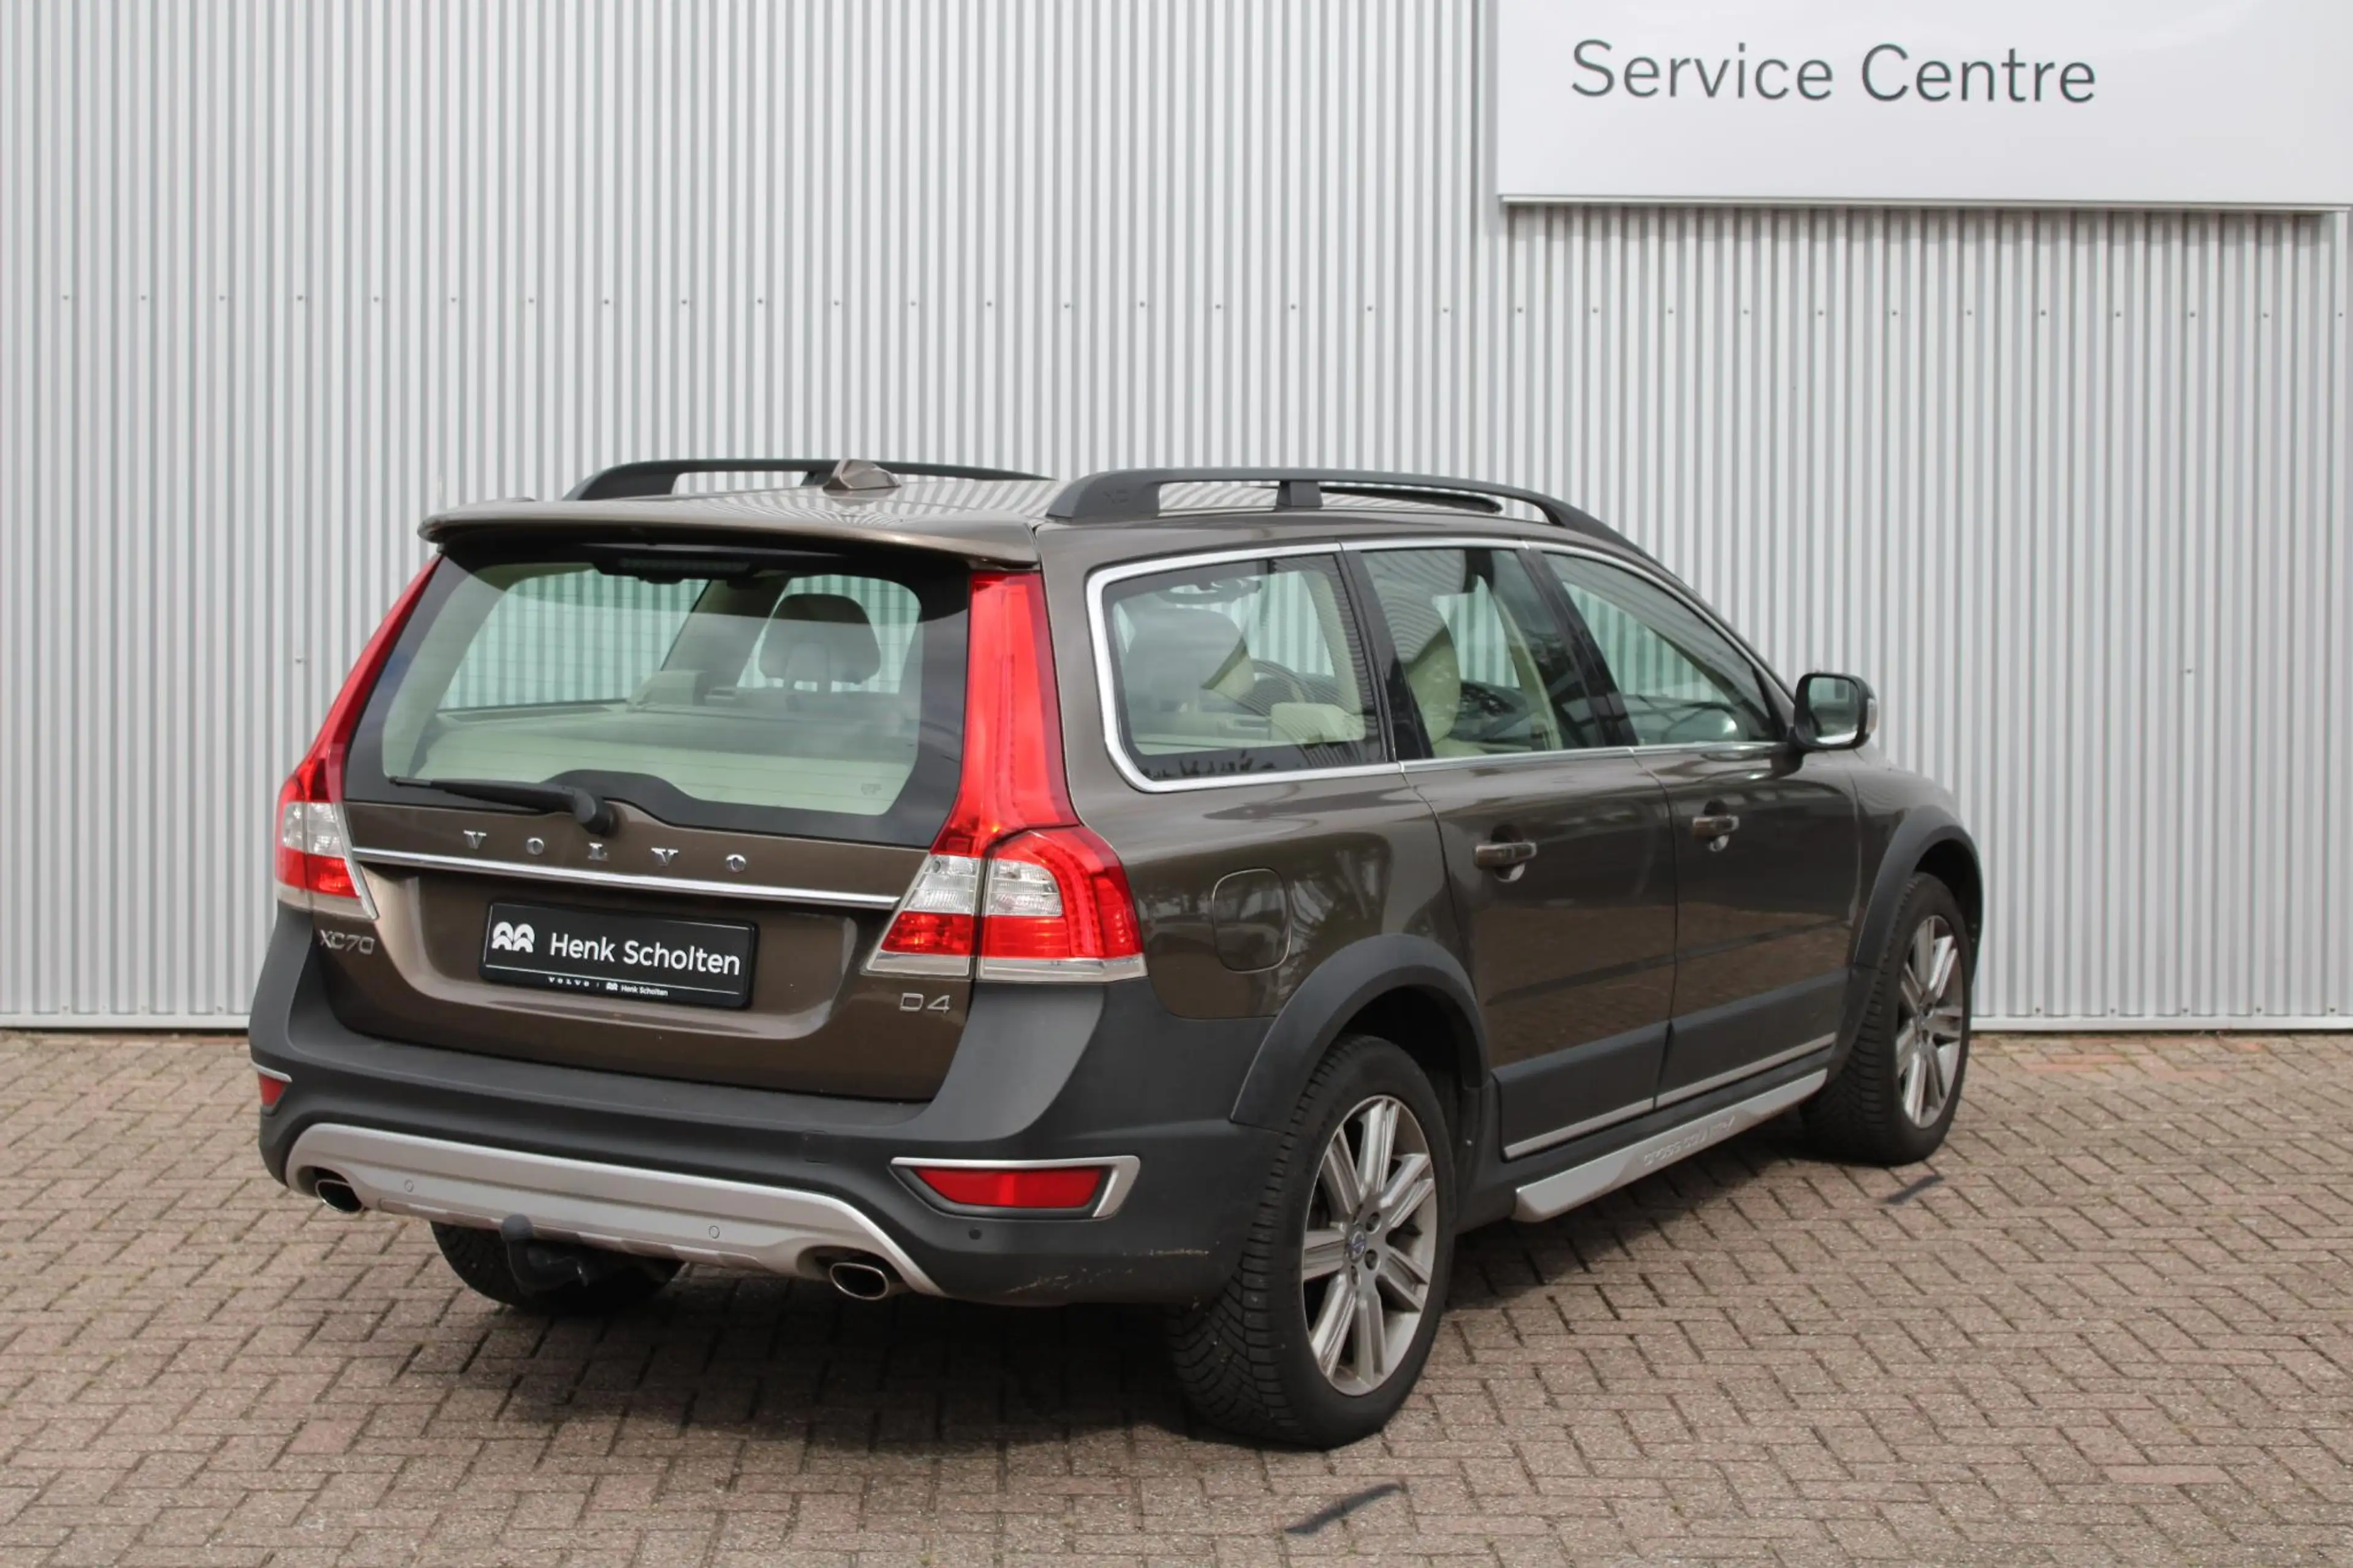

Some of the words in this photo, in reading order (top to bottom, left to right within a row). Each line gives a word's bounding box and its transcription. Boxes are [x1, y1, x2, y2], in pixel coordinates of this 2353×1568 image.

[1571, 39, 1833, 102] Service
[1860, 44, 2096, 104] Centre
[463, 829, 747, 873] VOLVO
[319, 928, 375, 955] XC70
[549, 932, 615, 962] Henk
[623, 940, 740, 975] Scholten
[548, 976, 589, 987] VOLVO
[621, 984, 638, 993] Henk
[639, 986, 669, 996] Scholten
[899, 992, 950, 1015] D4
